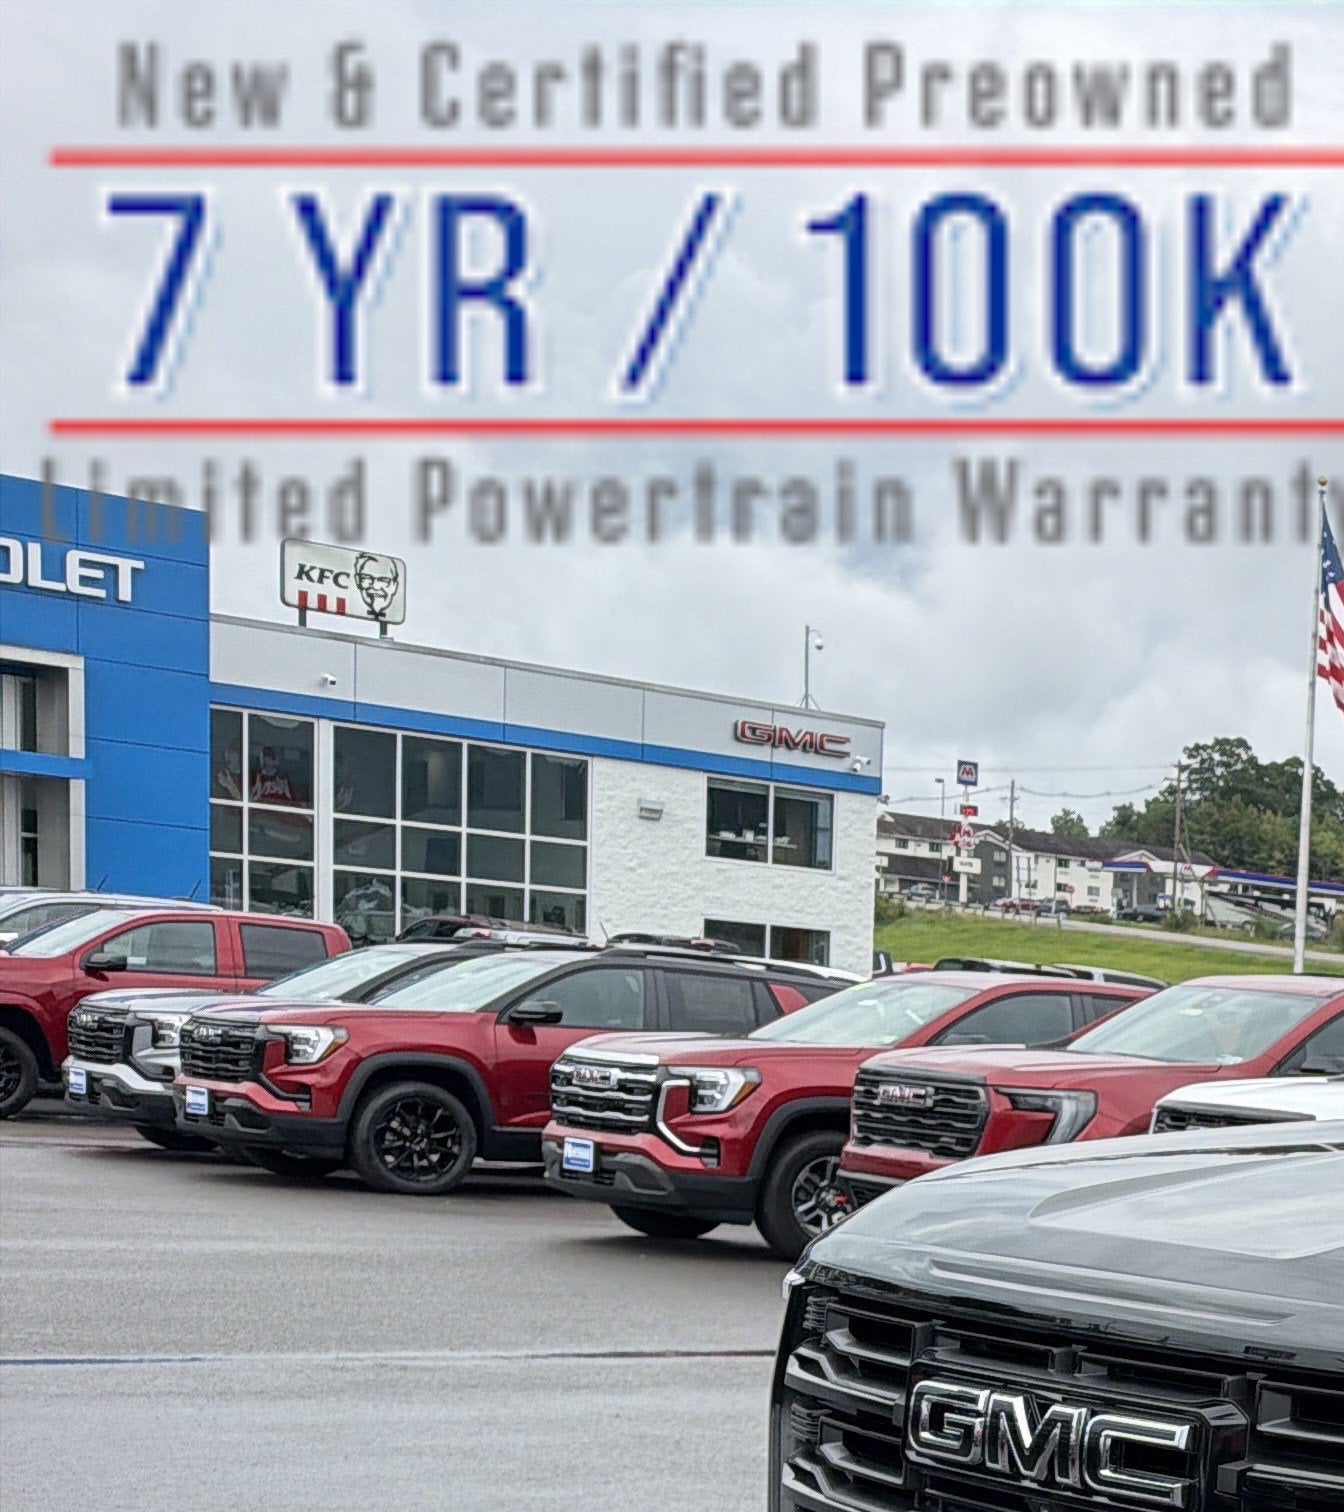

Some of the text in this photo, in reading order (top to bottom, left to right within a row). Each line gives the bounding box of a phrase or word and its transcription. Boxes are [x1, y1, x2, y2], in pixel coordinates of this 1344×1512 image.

[294, 562, 351, 590] KFC
[734, 720, 851, 759] GMC
[907, 1380, 1192, 1509] GMC
